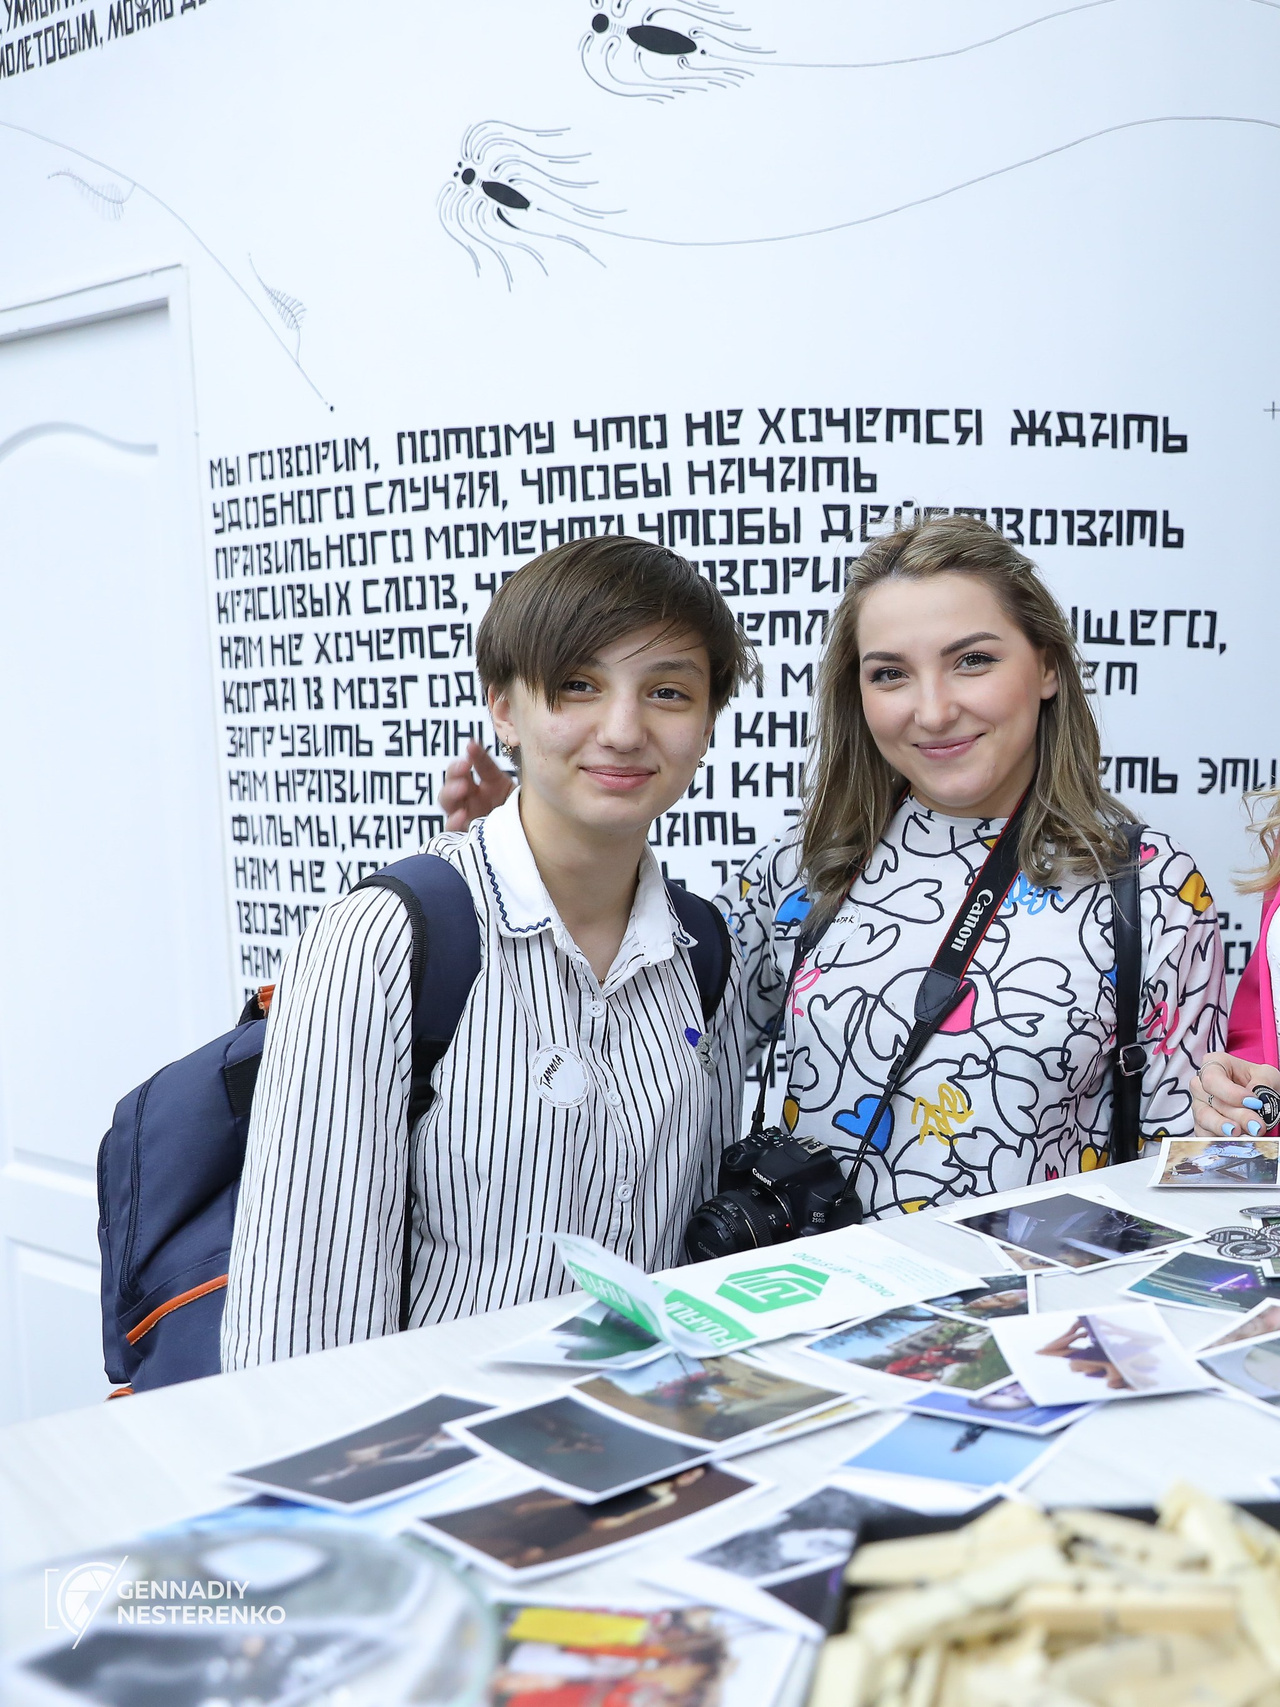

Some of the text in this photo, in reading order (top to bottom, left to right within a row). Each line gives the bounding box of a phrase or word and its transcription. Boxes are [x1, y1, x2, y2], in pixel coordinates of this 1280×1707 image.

[210, 408, 1188, 489] МЫ ГОВОРИМ, ПОТОМУ ЧТО НЕ ХОЧЕТСЯ ЖДАТЬ
[212, 456, 878, 534] УДОБНОГО СЛУЧАЯ, ЧТОБЫ НАЧАТЬ
[215, 529, 414, 579] ПРАВИЛЬНОГО
[638, 507, 801, 547] ЧТОБЫ
[216, 581, 351, 624] КРАСИВЫХ
[362, 574, 469, 615] СЛОВ,
[220, 635, 264, 669] НАМ
[271, 633, 303, 667] НЕ
[314, 622, 473, 664] ХОЧЕТСЯ
[223, 677, 296, 714] КОГДА
[303, 676, 324, 710] В
[334, 675, 418, 710] МОЗГ
[226, 724, 373, 758] ЗАГРУЗИТЬ
[228, 769, 268, 802] НАМ
[276, 768, 433, 806] НРАВИТСЯ
[1198, 757, 1277, 795] ЭТИ
[235, 857, 280, 892] НАМ
[290, 860, 326, 893] НЕ
[951, 888, 994, 952] Canon
[241, 945, 282, 978] НАМ
[752, 1167, 772, 1187] Canon
